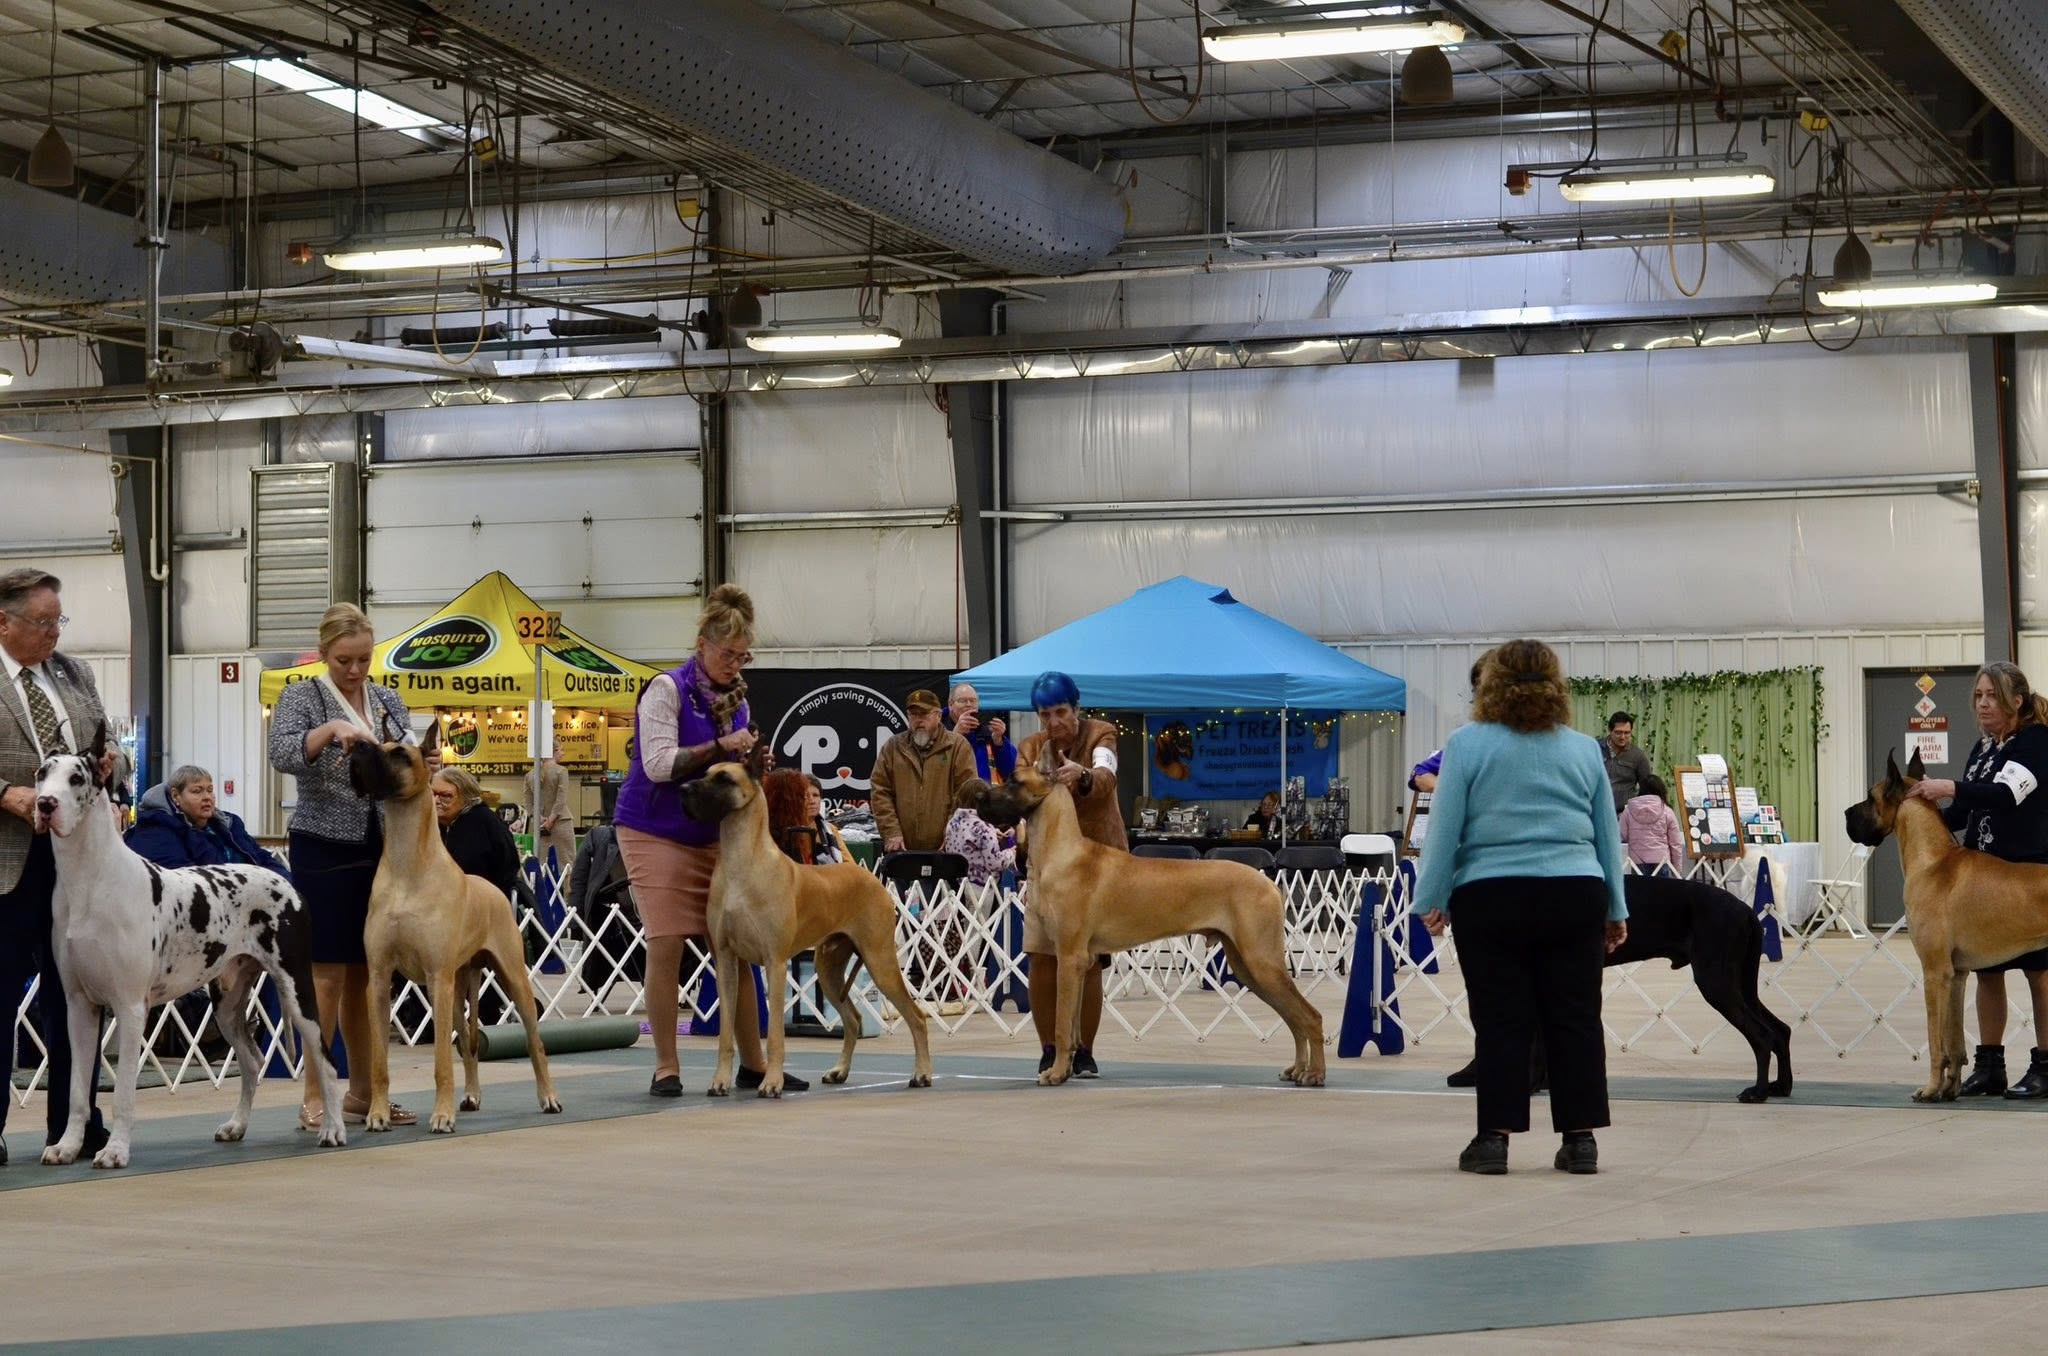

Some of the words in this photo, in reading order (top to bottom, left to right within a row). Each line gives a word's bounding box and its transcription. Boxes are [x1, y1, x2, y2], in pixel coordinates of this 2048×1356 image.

[518, 616, 545, 638] 32
[546, 616, 560, 638] 32
[408, 632, 487, 649] MOSQUITO
[400, 646, 477, 663] JOE
[226, 664, 235, 680] 3
[383, 673, 399, 689] is
[407, 672, 444, 690] fun
[451, 673, 521, 695] again.
[564, 672, 621, 693] Outside
[624, 676, 635, 693] is
[798, 693, 829, 717] simply
[831, 690, 865, 704] saving
[866, 696, 901, 729] puppies
[488, 735, 515, 744] We've
[1917, 735, 1936, 743] FIRE
